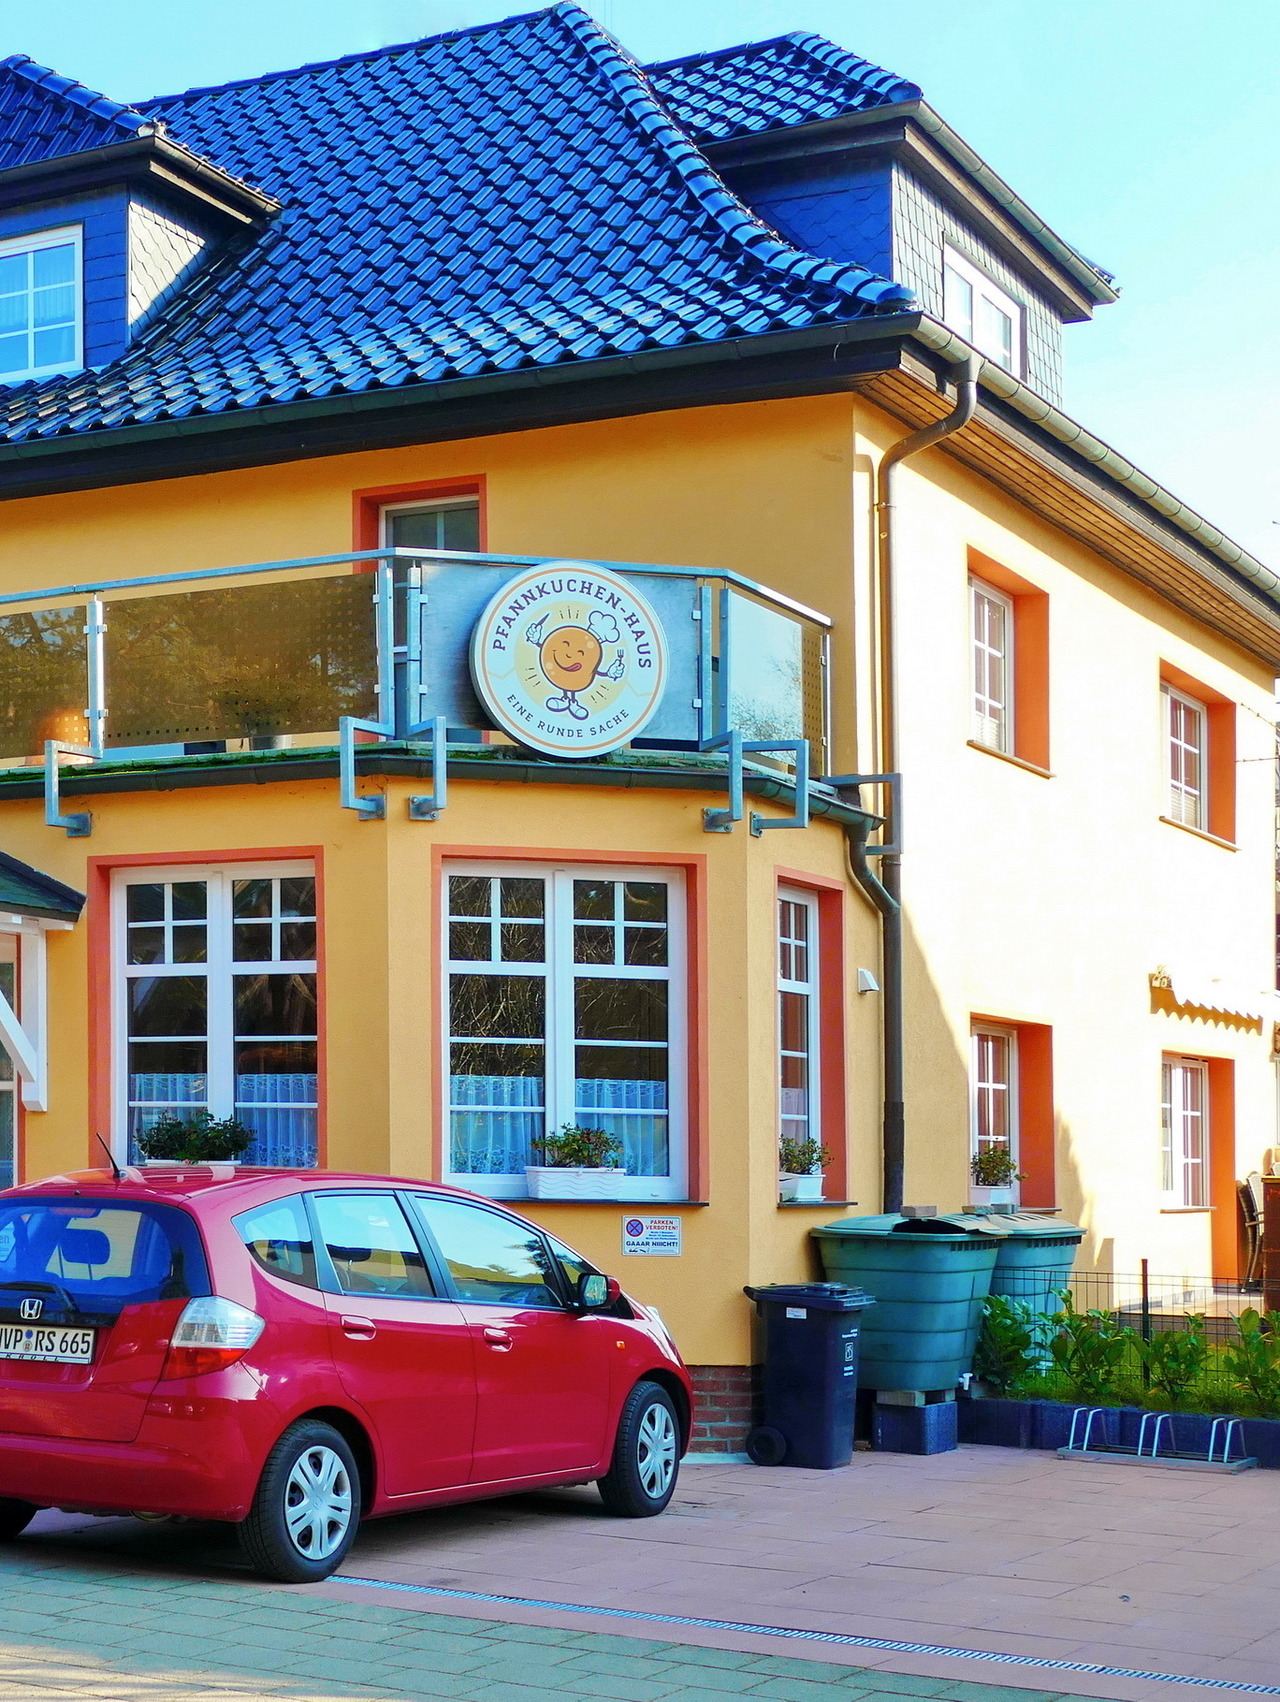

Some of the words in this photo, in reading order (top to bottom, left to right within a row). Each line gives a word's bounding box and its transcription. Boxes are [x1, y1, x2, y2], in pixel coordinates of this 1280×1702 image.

[492, 578, 652, 669] PFANNKUCHEN-HAUS
[506, 693, 532, 722] EINE
[537, 720, 584, 738] RUNDE
[589, 709, 629, 737] SACHE
[34, 1330, 56, 1352] RS
[59, 1332, 91, 1354] 665
